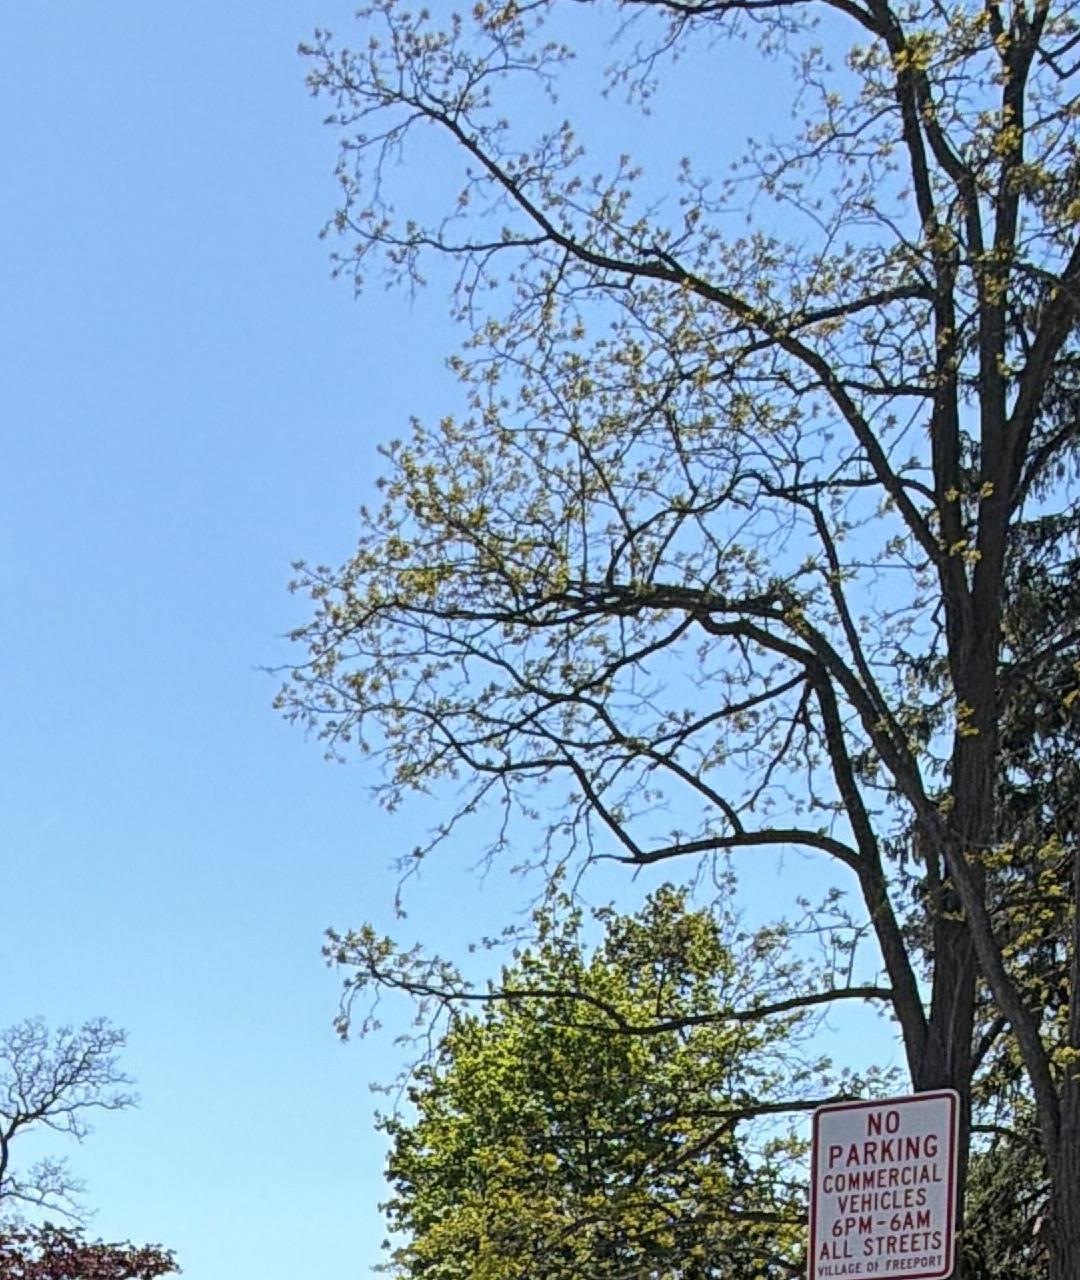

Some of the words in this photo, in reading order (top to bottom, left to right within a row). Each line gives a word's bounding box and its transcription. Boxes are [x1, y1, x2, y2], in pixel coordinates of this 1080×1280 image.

[867, 1111, 899, 1136] NO
[828, 1134, 938, 1169] PARKING
[822, 1162, 942, 1194] COMMERCIAL
[838, 1188, 927, 1214] VEHICLES
[820, 1240, 853, 1260] ALL
[862, 1231, 942, 1257] STREETS
[818, 1262, 862, 1277] VILLAGE
[867, 1260, 880, 1273] OF
[885, 1255, 942, 1272] FREEPORT
